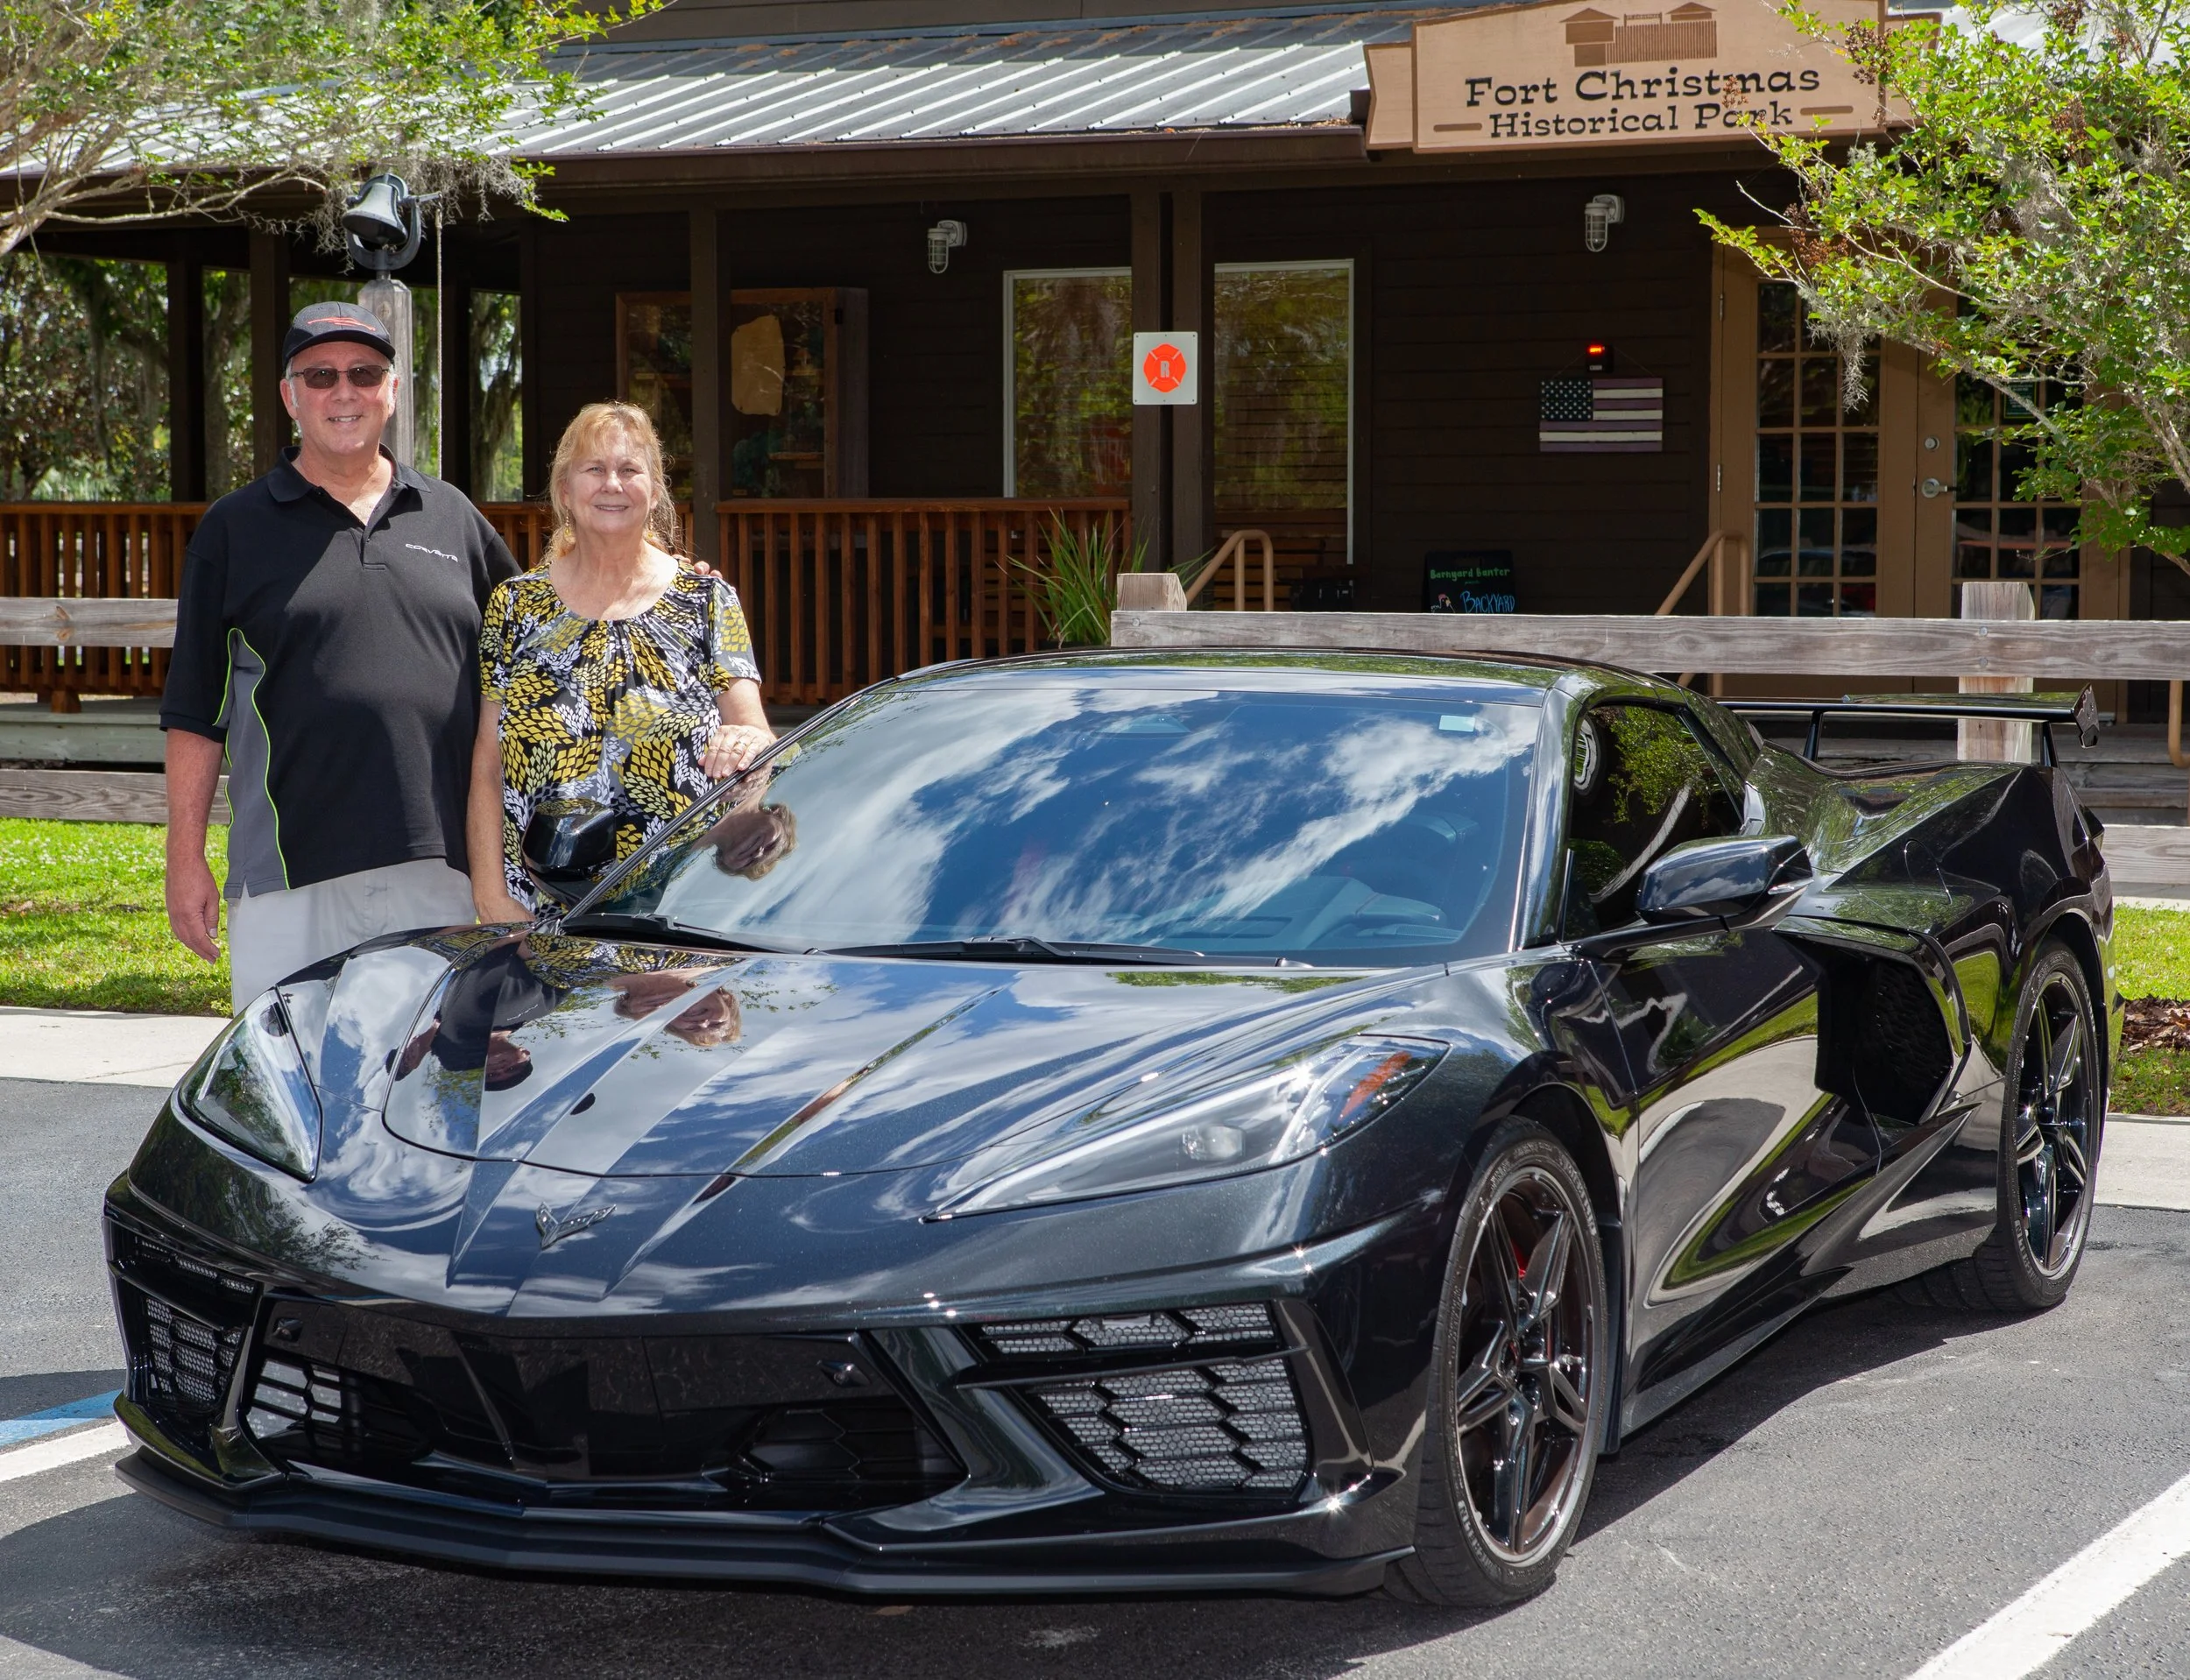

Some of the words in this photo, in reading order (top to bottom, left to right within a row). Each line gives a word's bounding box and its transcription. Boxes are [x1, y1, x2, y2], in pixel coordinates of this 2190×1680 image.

[1465, 77, 1558, 107] Fort
[1575, 67, 1819, 102] Christmas
[1489, 105, 1678, 138] Historical
[1160, 360, 1170, 378] R
[1430, 568, 1473, 582] Barnyard
